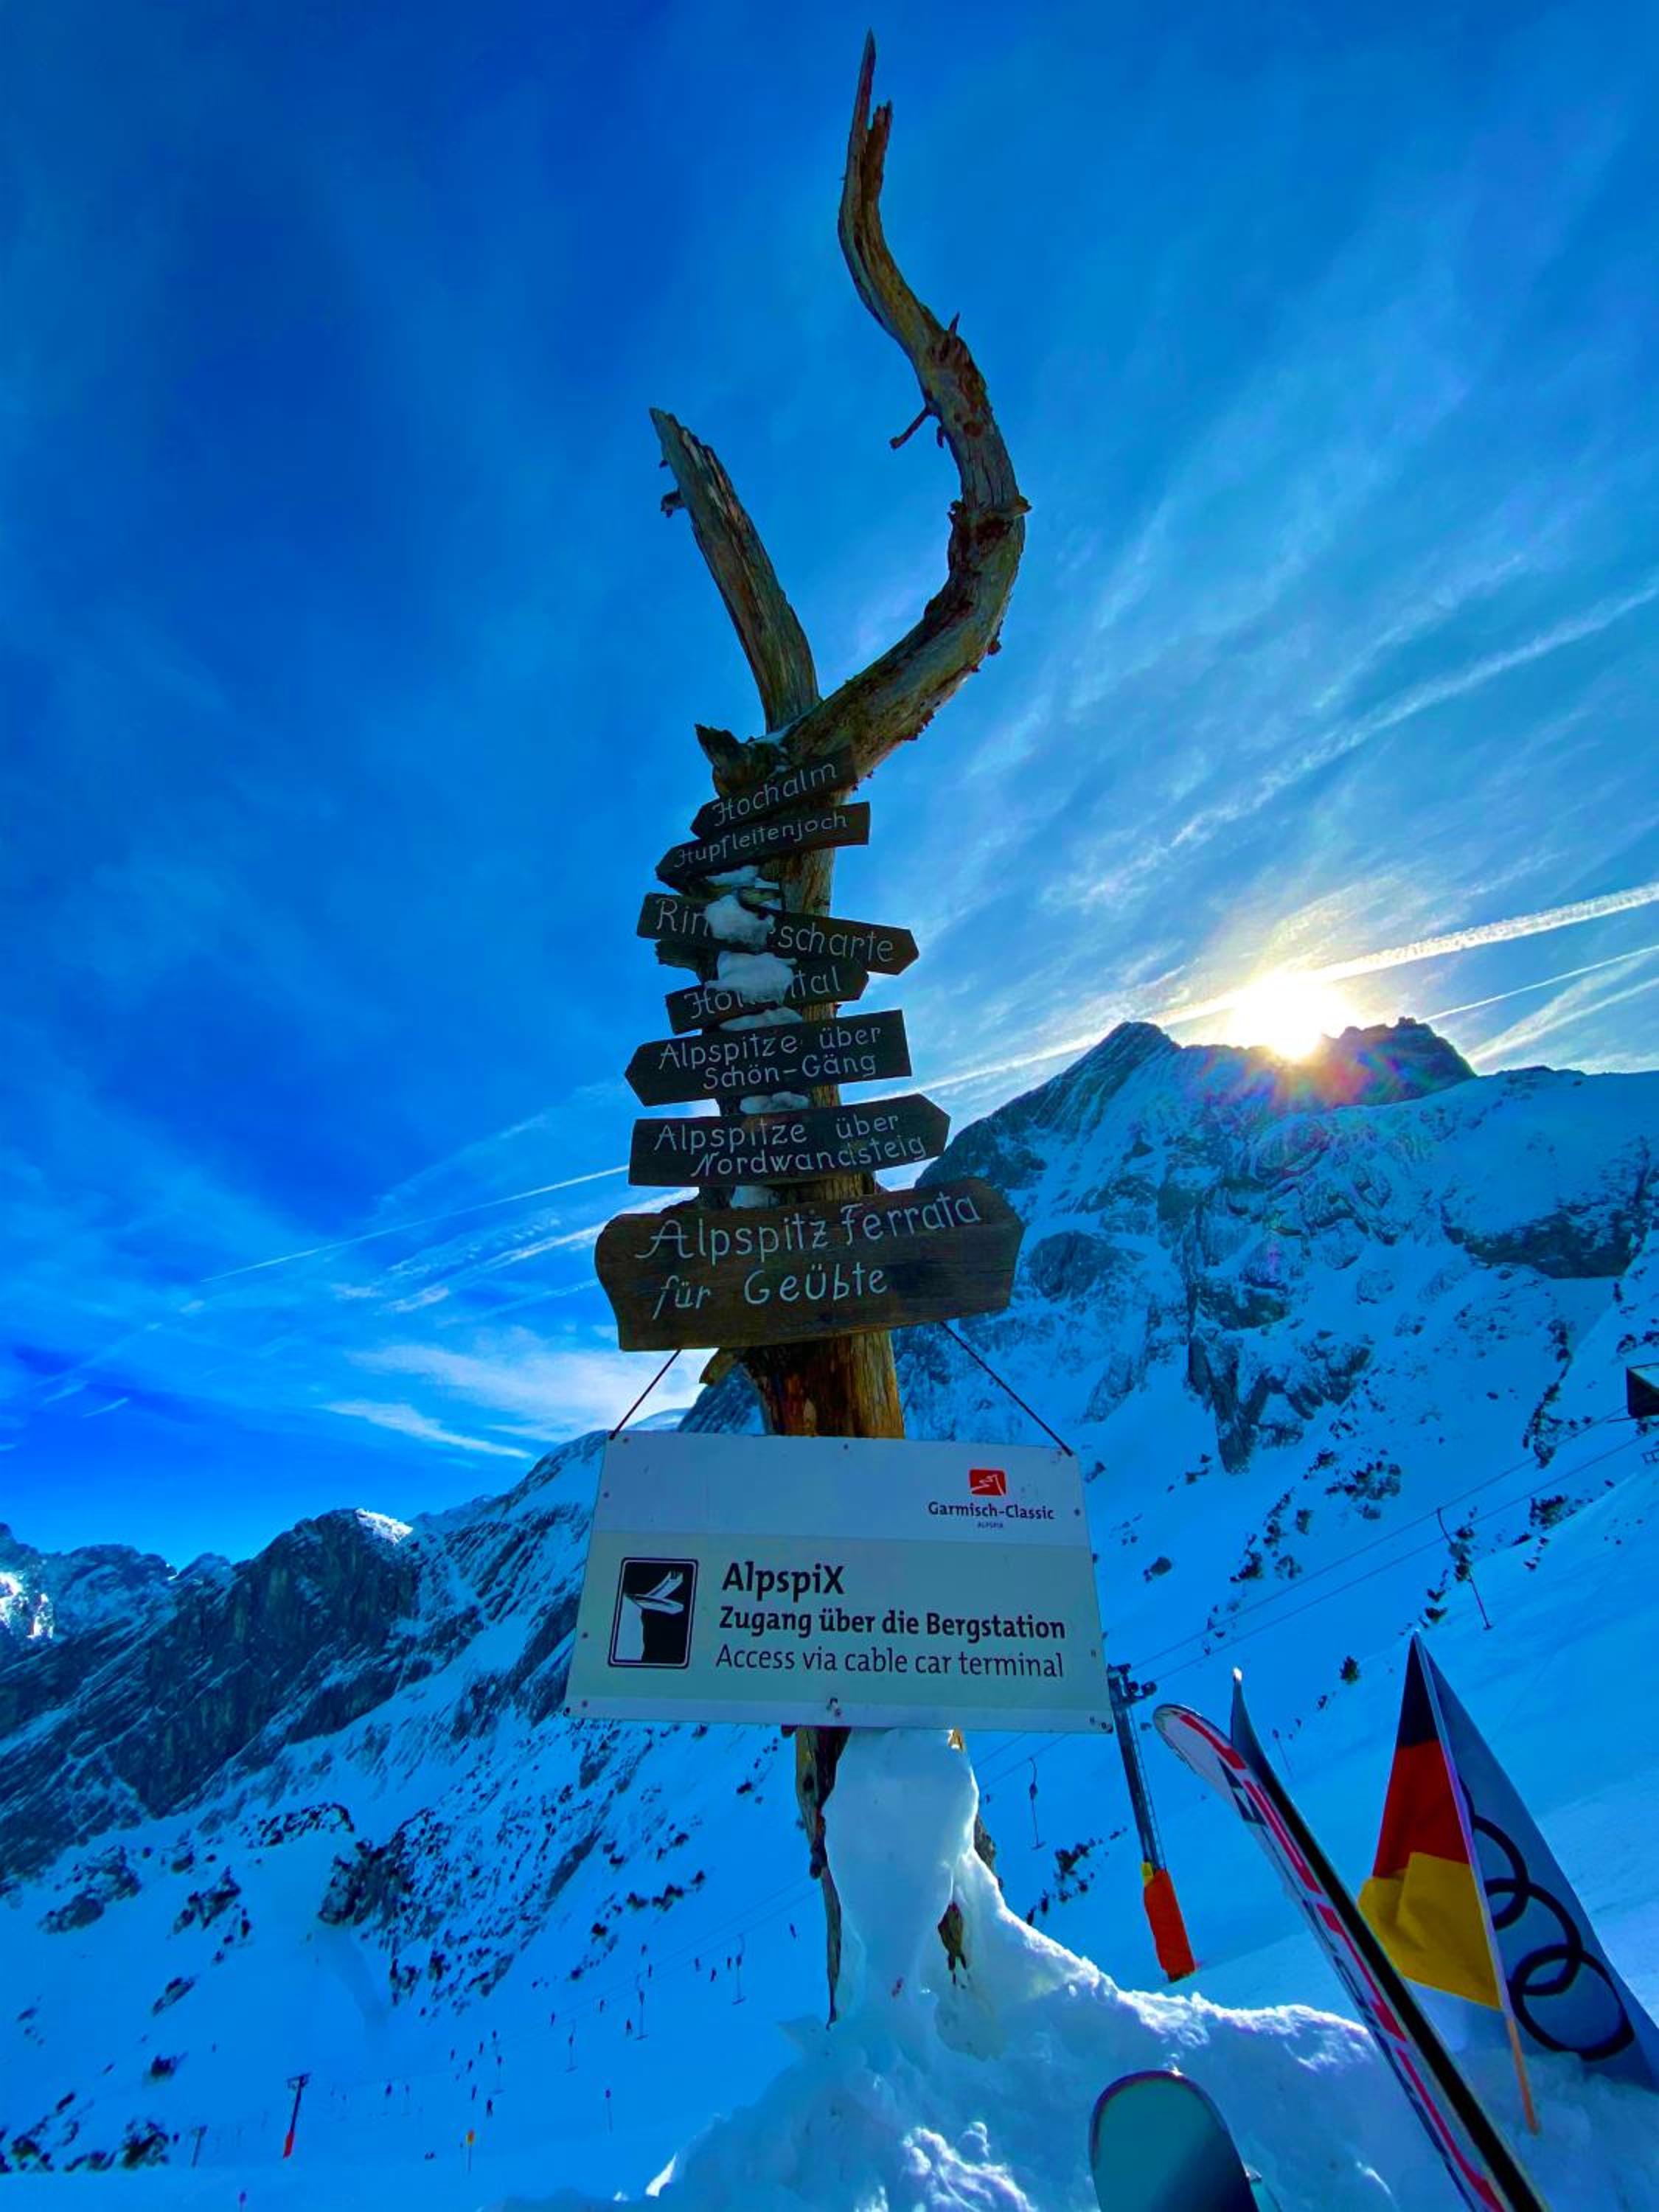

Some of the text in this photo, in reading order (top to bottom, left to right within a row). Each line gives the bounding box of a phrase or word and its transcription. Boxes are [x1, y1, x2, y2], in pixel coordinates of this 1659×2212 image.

[712, 762, 838, 827] Hochalm
[674, 812, 848, 869] Hupfleitenjoch
[659, 1025, 882, 1070] Alpspitze über
[703, 1053, 877, 1091] Schön-Gäng
[653, 1113, 900, 1152] Alpspitze über
[691, 1135, 927, 1179] Nordwandsteig
[636, 1190, 981, 1266] Alpspitz Ferrata
[653, 1274, 712, 1320] für
[928, 1501, 1055, 1520] Garmisch-Classic
[722, 1561, 844, 1603] AlpspiX
[719, 1606, 1066, 1644] Zugang über die Bergstation
[715, 1644, 1063, 1677] Access via cable car terminal
